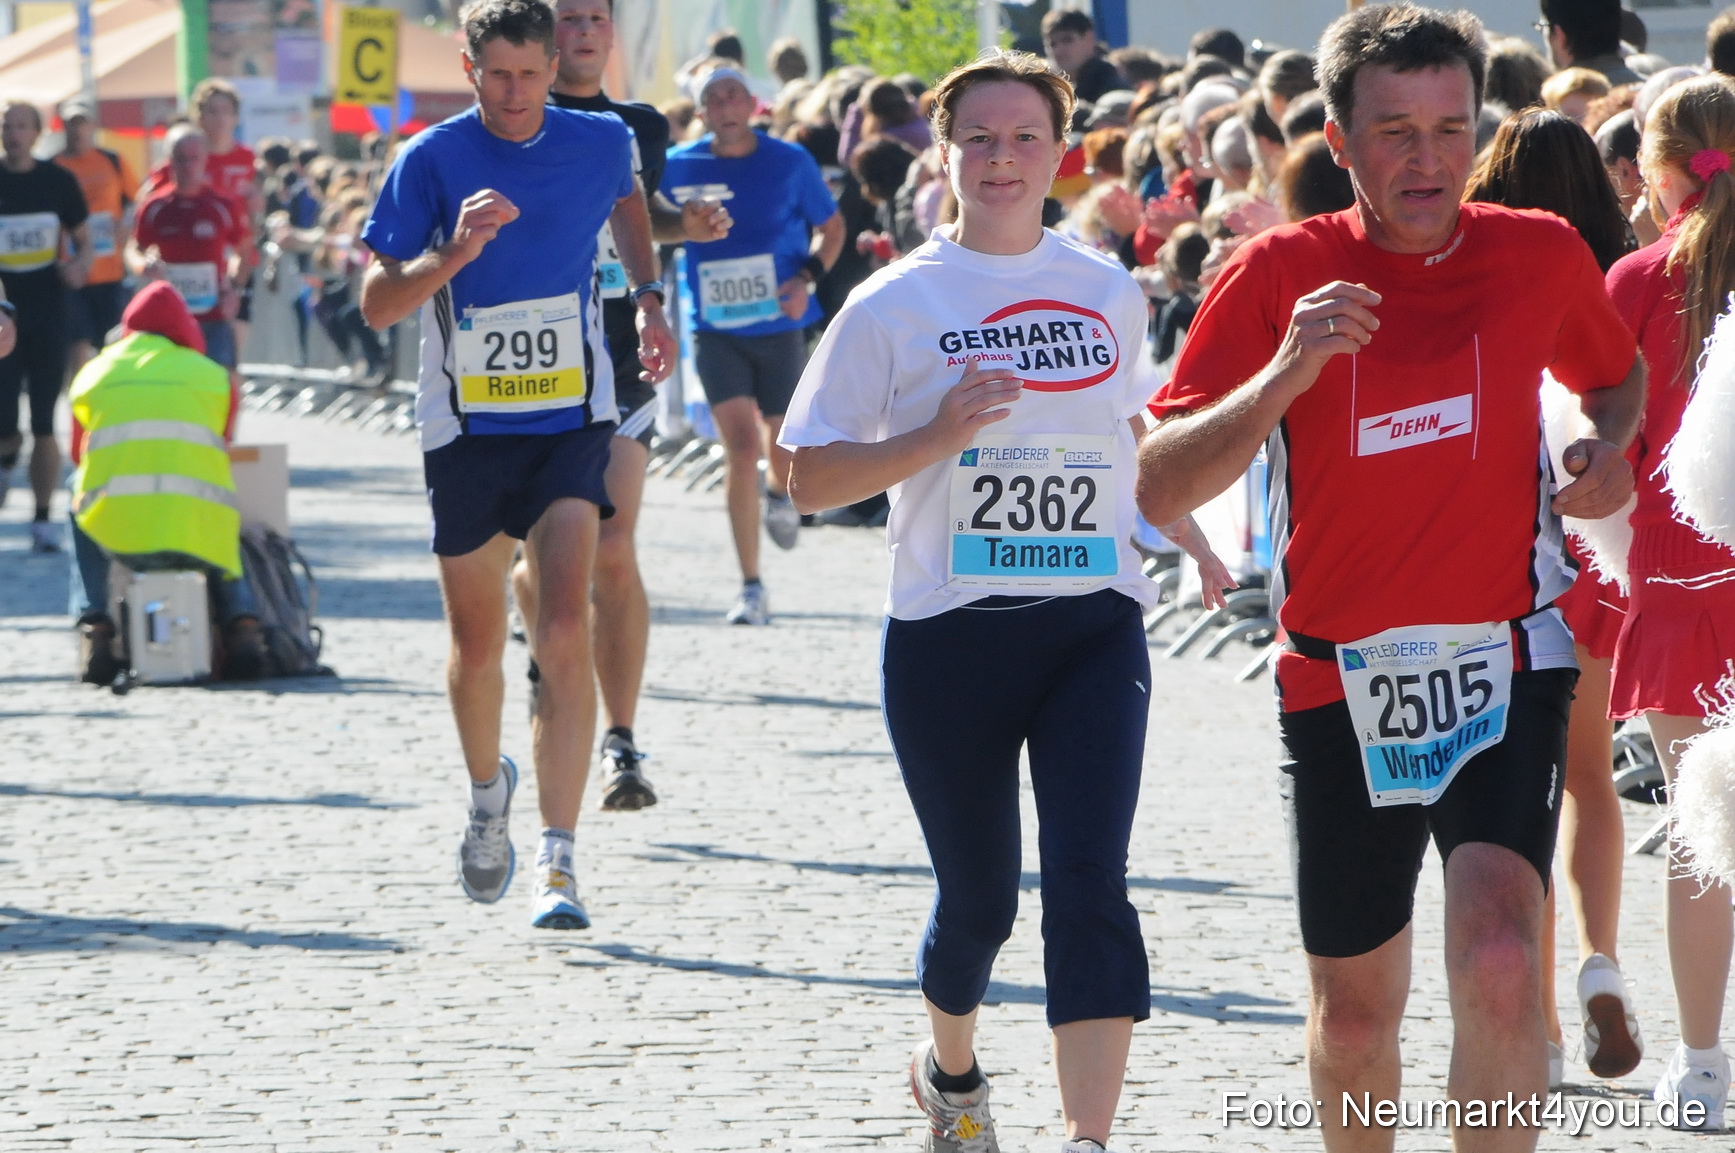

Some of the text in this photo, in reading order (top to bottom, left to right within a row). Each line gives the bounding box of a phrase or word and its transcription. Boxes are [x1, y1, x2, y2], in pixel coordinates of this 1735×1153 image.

[353, 38, 383, 84] C
[709, 275, 768, 303] 3005
[484, 328, 558, 371] 299
[939, 321, 1102, 354] GERHART &
[1016, 341, 1111, 371] JÄNIG
[488, 375, 559, 397] Rainer
[1390, 412, 1441, 439] DEHN
[980, 461, 1049, 470] AKTIENGESELLSCHAFT
[981, 447, 1103, 462] PFLEIDERER BOCK
[957, 475, 1097, 532] B 2362
[984, 537, 1089, 568] Tamara
[1361, 641, 1438, 660] PFLEIDERER
[1366, 660, 1493, 742] A 2505
[1381, 717, 1490, 780] Wendelin
